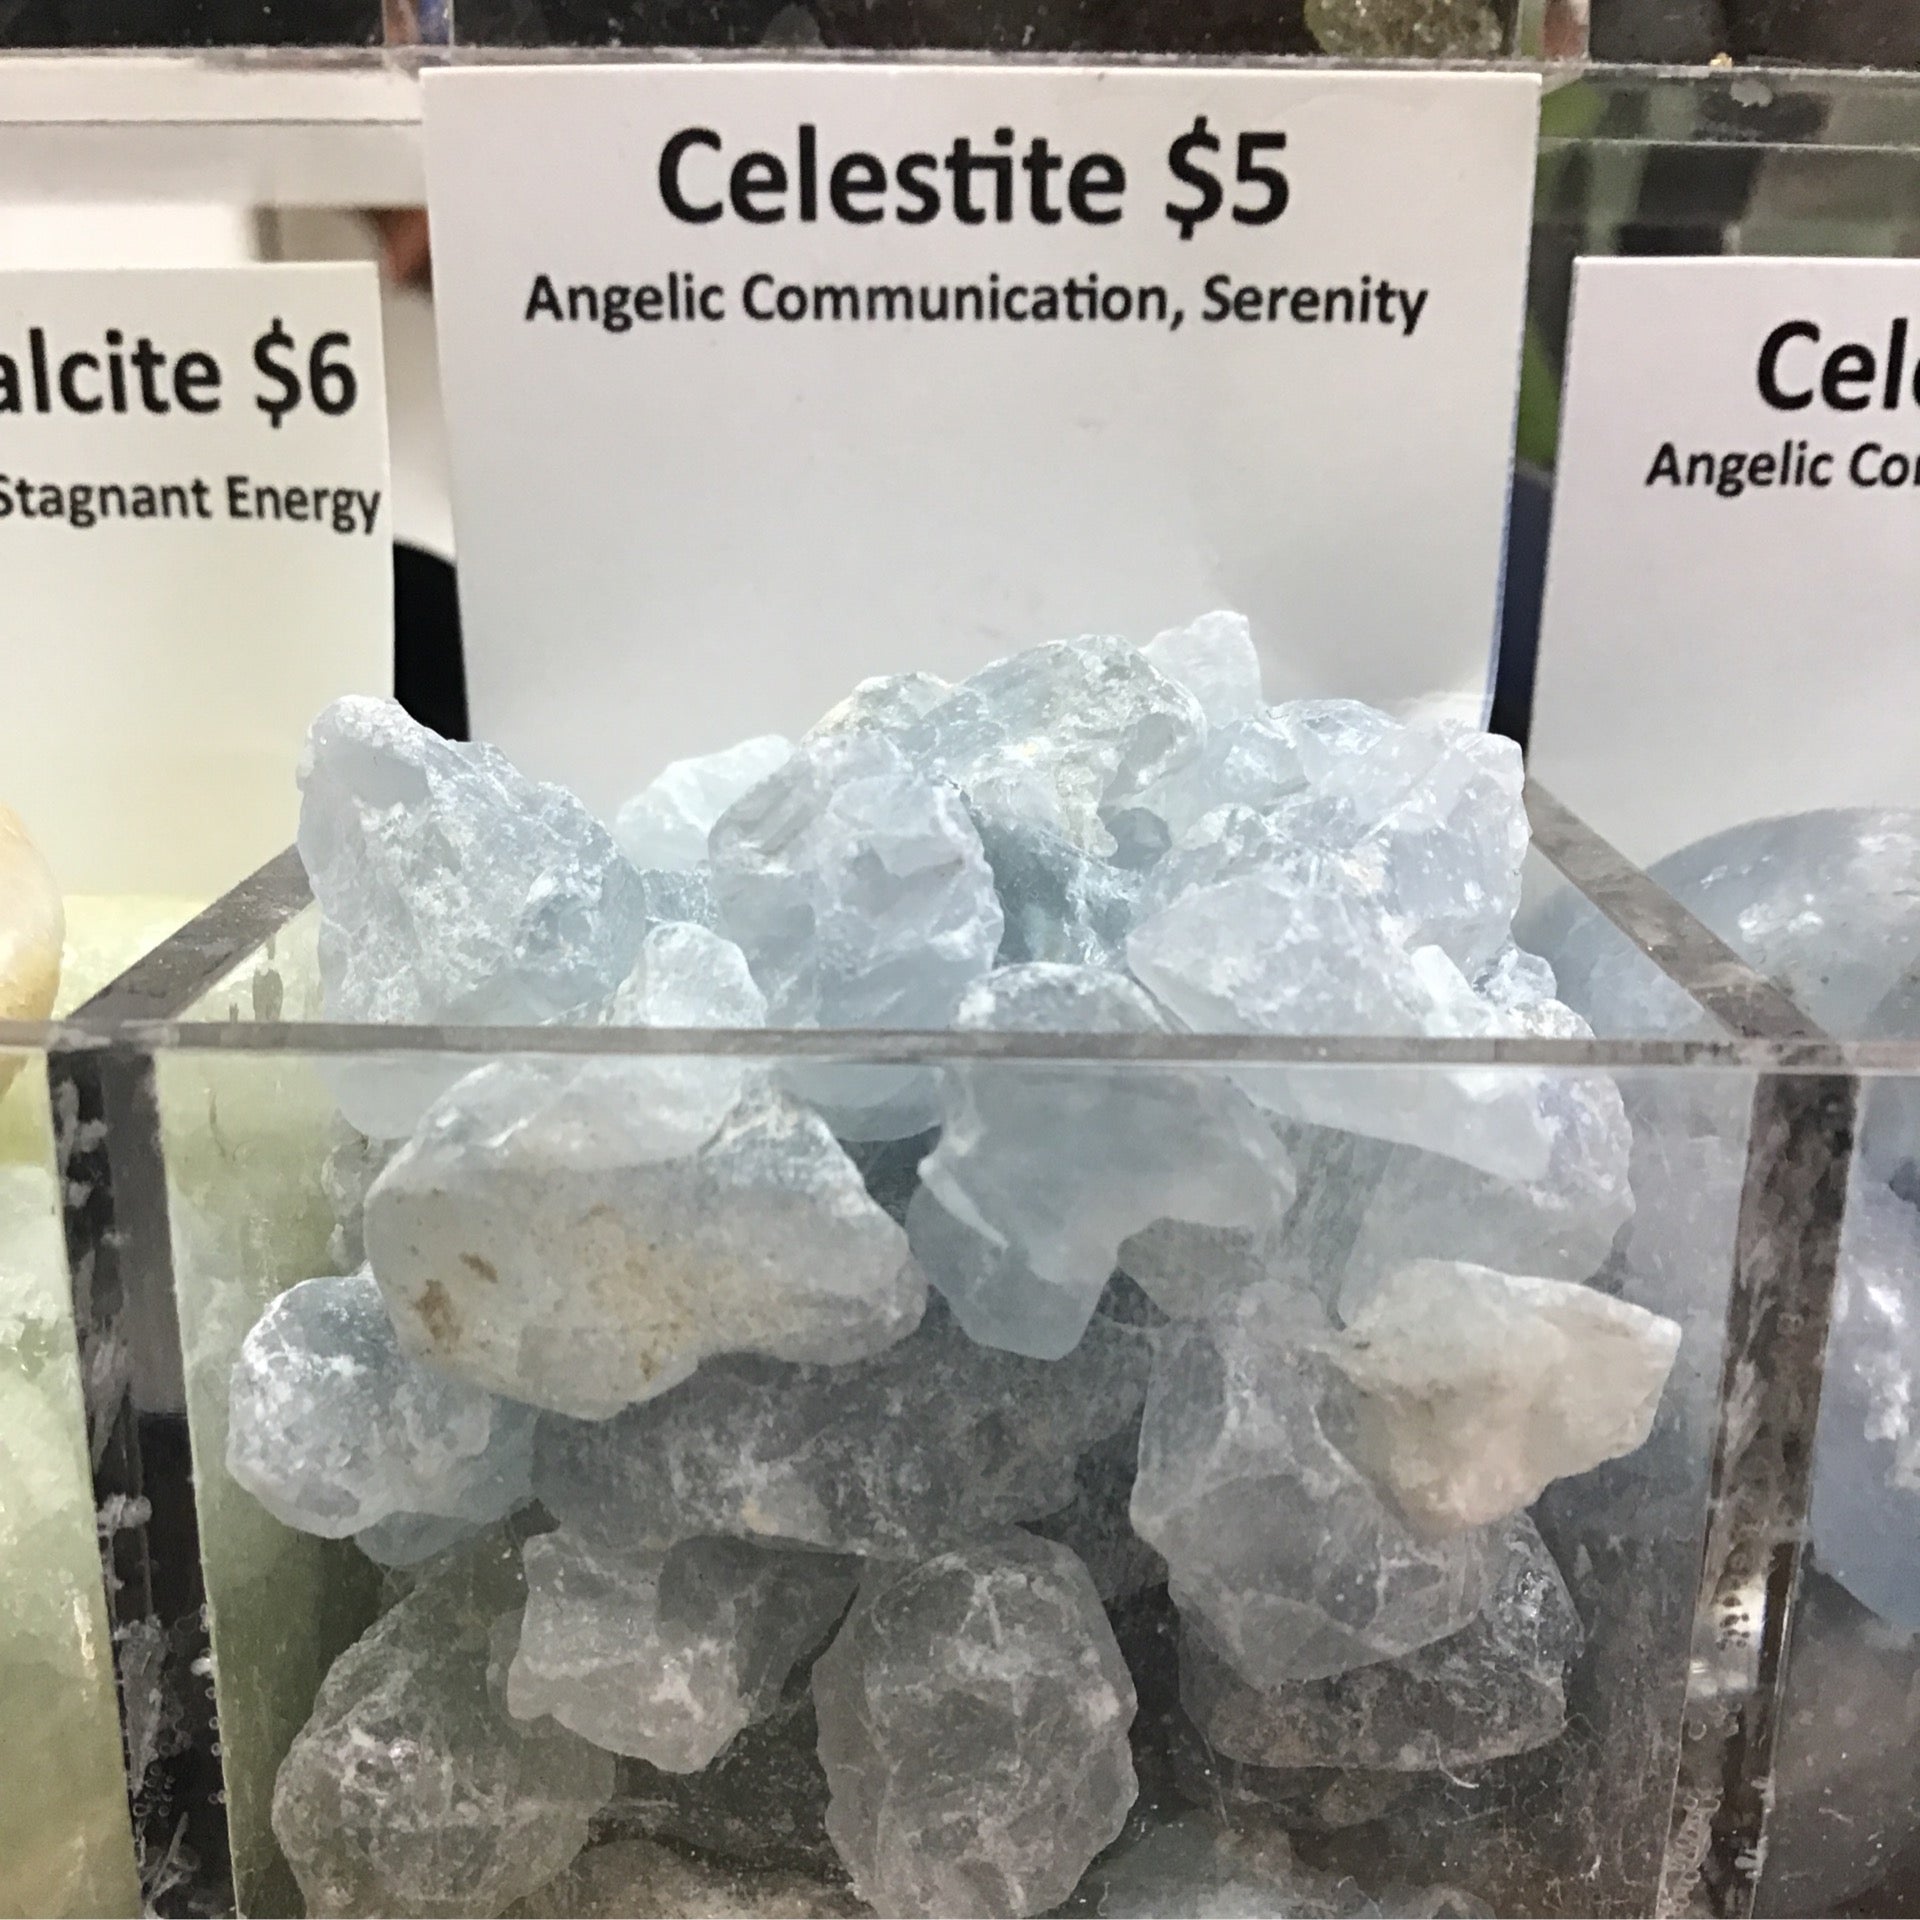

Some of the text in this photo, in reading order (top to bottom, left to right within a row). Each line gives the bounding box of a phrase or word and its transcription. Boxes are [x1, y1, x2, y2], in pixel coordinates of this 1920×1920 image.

[657, 115, 1292, 241] Celestite $5
[525, 271, 1430, 336] Angelic Communication, Serenity
[252, 317, 358, 430] $6
[1755, 316, 1920, 413] Cel
[225, 475, 382, 536] Energy
[1644, 439, 1920, 499] Angelic Co
